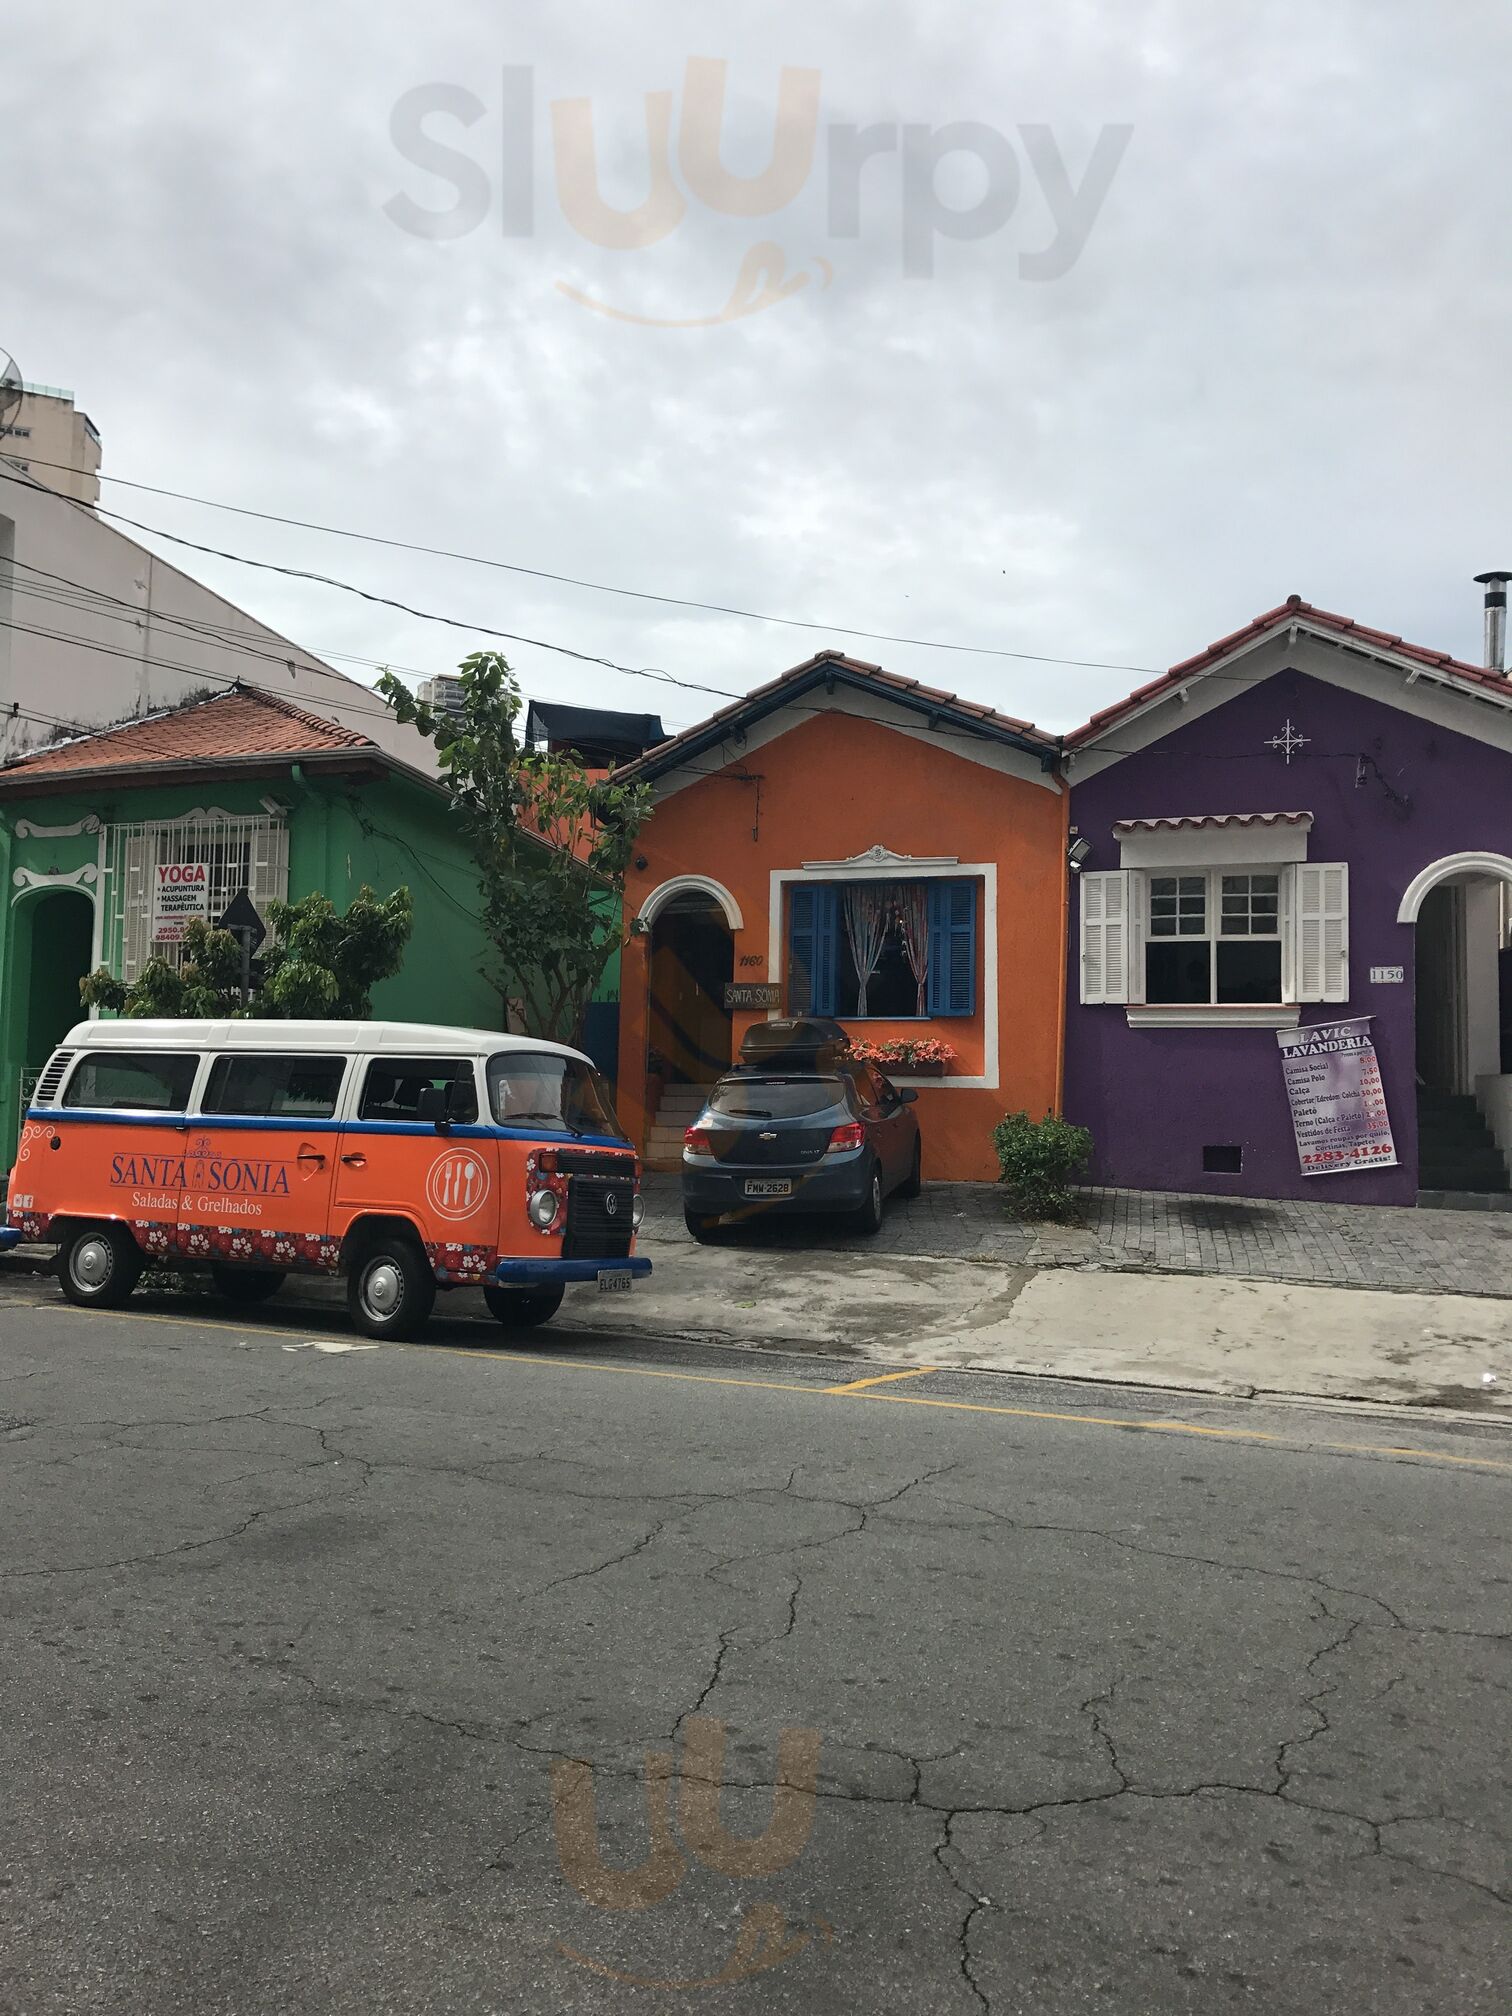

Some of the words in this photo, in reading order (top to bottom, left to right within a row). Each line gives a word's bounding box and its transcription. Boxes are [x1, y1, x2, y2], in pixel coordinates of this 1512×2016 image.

[158, 865, 205, 883] YOGA
[161, 902, 204, 911] TERAPÊUTICA
[1372, 970, 1402, 979] 1150
[726, 989, 752, 1003] SANTA
[1300, 1026, 1351, 1044] LAVIC
[1283, 1035, 1372, 1058] LAVANDERIA
[1285, 1066, 1308, 1075] Camisa
[1309, 1062, 1328, 1071] Social
[1287, 1076, 1310, 1085] Camisa
[1311, 1073, 1325, 1082] Polo
[1360, 1077, 1380, 1086] 10,00
[1289, 1087, 1310, 1096] Calça
[1361, 1087, 1382, 1097] 30,00
[1364, 1099, 1384, 1107] 1,00
[1293, 1107, 1317, 1117] Paletó
[1366, 1110, 1386, 1118] 2,00
[1294, 1119, 1314, 1128] Terno
[1297, 1128, 1324, 1138] Vestidos
[1325, 1127, 1332, 1135] de
[1333, 1125, 1351, 1134] Festa
[1299, 1138, 1328, 1147] Lavamos
[1330, 1136, 1354, 1144] roupas
[1348, 1139, 1375, 1148] Tapetes
[1302, 1143, 1392, 1164] 2283-4126
[1307, 1161, 1351, 1171] Delivery
[1354, 1155, 1391, 1165] Grátis!
[110, 1155, 187, 1187] SANTA
[208, 1159, 290, 1194] SÔNIA
[132, 1192, 178, 1209] Saladas
[181, 1195, 193, 1210] &
[197, 1196, 262, 1216] Grelhados
